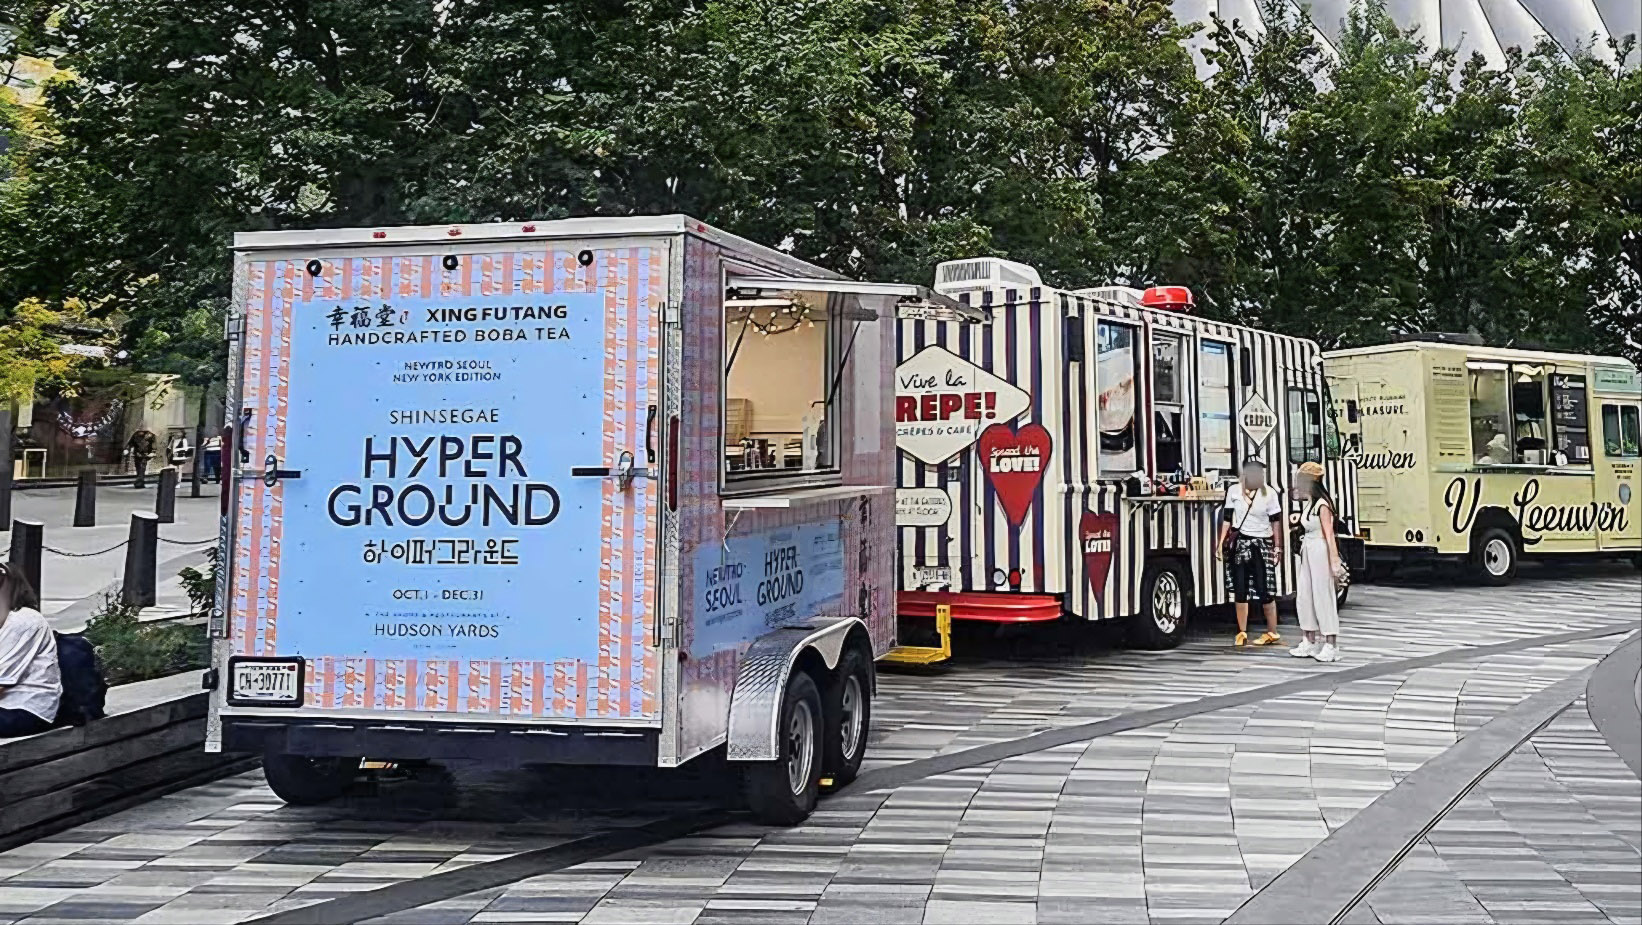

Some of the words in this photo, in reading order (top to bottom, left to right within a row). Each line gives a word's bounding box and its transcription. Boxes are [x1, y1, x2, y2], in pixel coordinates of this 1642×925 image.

[326, 304, 396, 331] 幸福堂
[328, 329, 467, 345] HANDCRAFTED
[474, 328, 528, 342] BOBA
[535, 327, 571, 340] TEA
[456, 359, 492, 370] SEOUL
[392, 373, 419, 383] NEW
[422, 372, 453, 382] YORK
[455, 371, 502, 382] EDITION
[900, 373, 938, 390] Vive
[945, 368, 967, 387] la
[389, 408, 500, 424] SHINSEGAE
[363, 435, 528, 479] HYPER
[990, 445, 1021, 458] Spread
[1024, 444, 1040, 455] the
[990, 456, 1041, 473] LOVE!
[327, 483, 561, 527] GROUND
[363, 538, 519, 564] 하이퍼그라운드
[764, 546, 798, 577] HYPER
[705, 583, 743, 613] SEOUL
[756, 570, 804, 606] GROUND
[375, 623, 443, 637] HUDSON
[448, 624, 500, 638] YARDS
